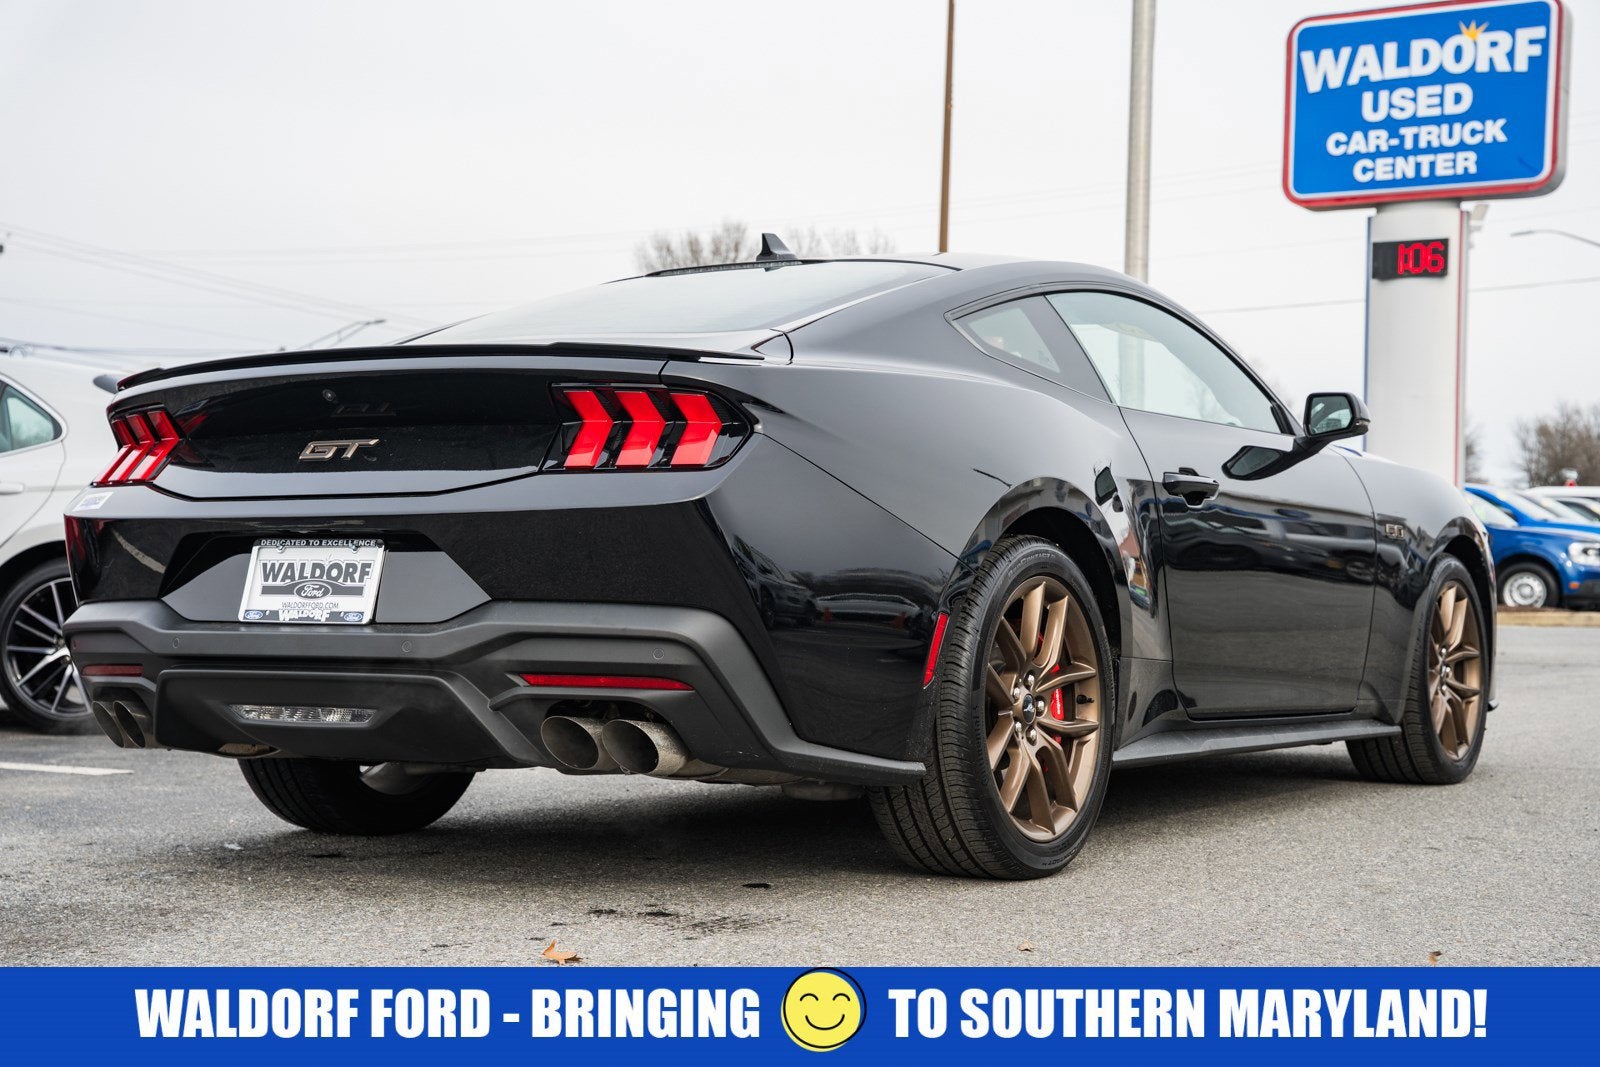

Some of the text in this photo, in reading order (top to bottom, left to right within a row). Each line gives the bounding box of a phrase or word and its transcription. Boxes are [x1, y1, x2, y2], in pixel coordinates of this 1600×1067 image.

[1300, 25, 1547, 94] WALDORF
[1361, 82, 1474, 122] USED
[1326, 118, 1508, 156] CAR-TRUCK
[1352, 151, 1478, 183] CENTER
[299, 439, 380, 461] GT
[260, 539, 377, 548] DEDICATED TO EXCELLENCE
[261, 560, 373, 583] WALDORF
[300, 584, 325, 598] Ford
[278, 608, 331, 622] WALDORF
[281, 601, 339, 609] WALDORFFORD.COM
